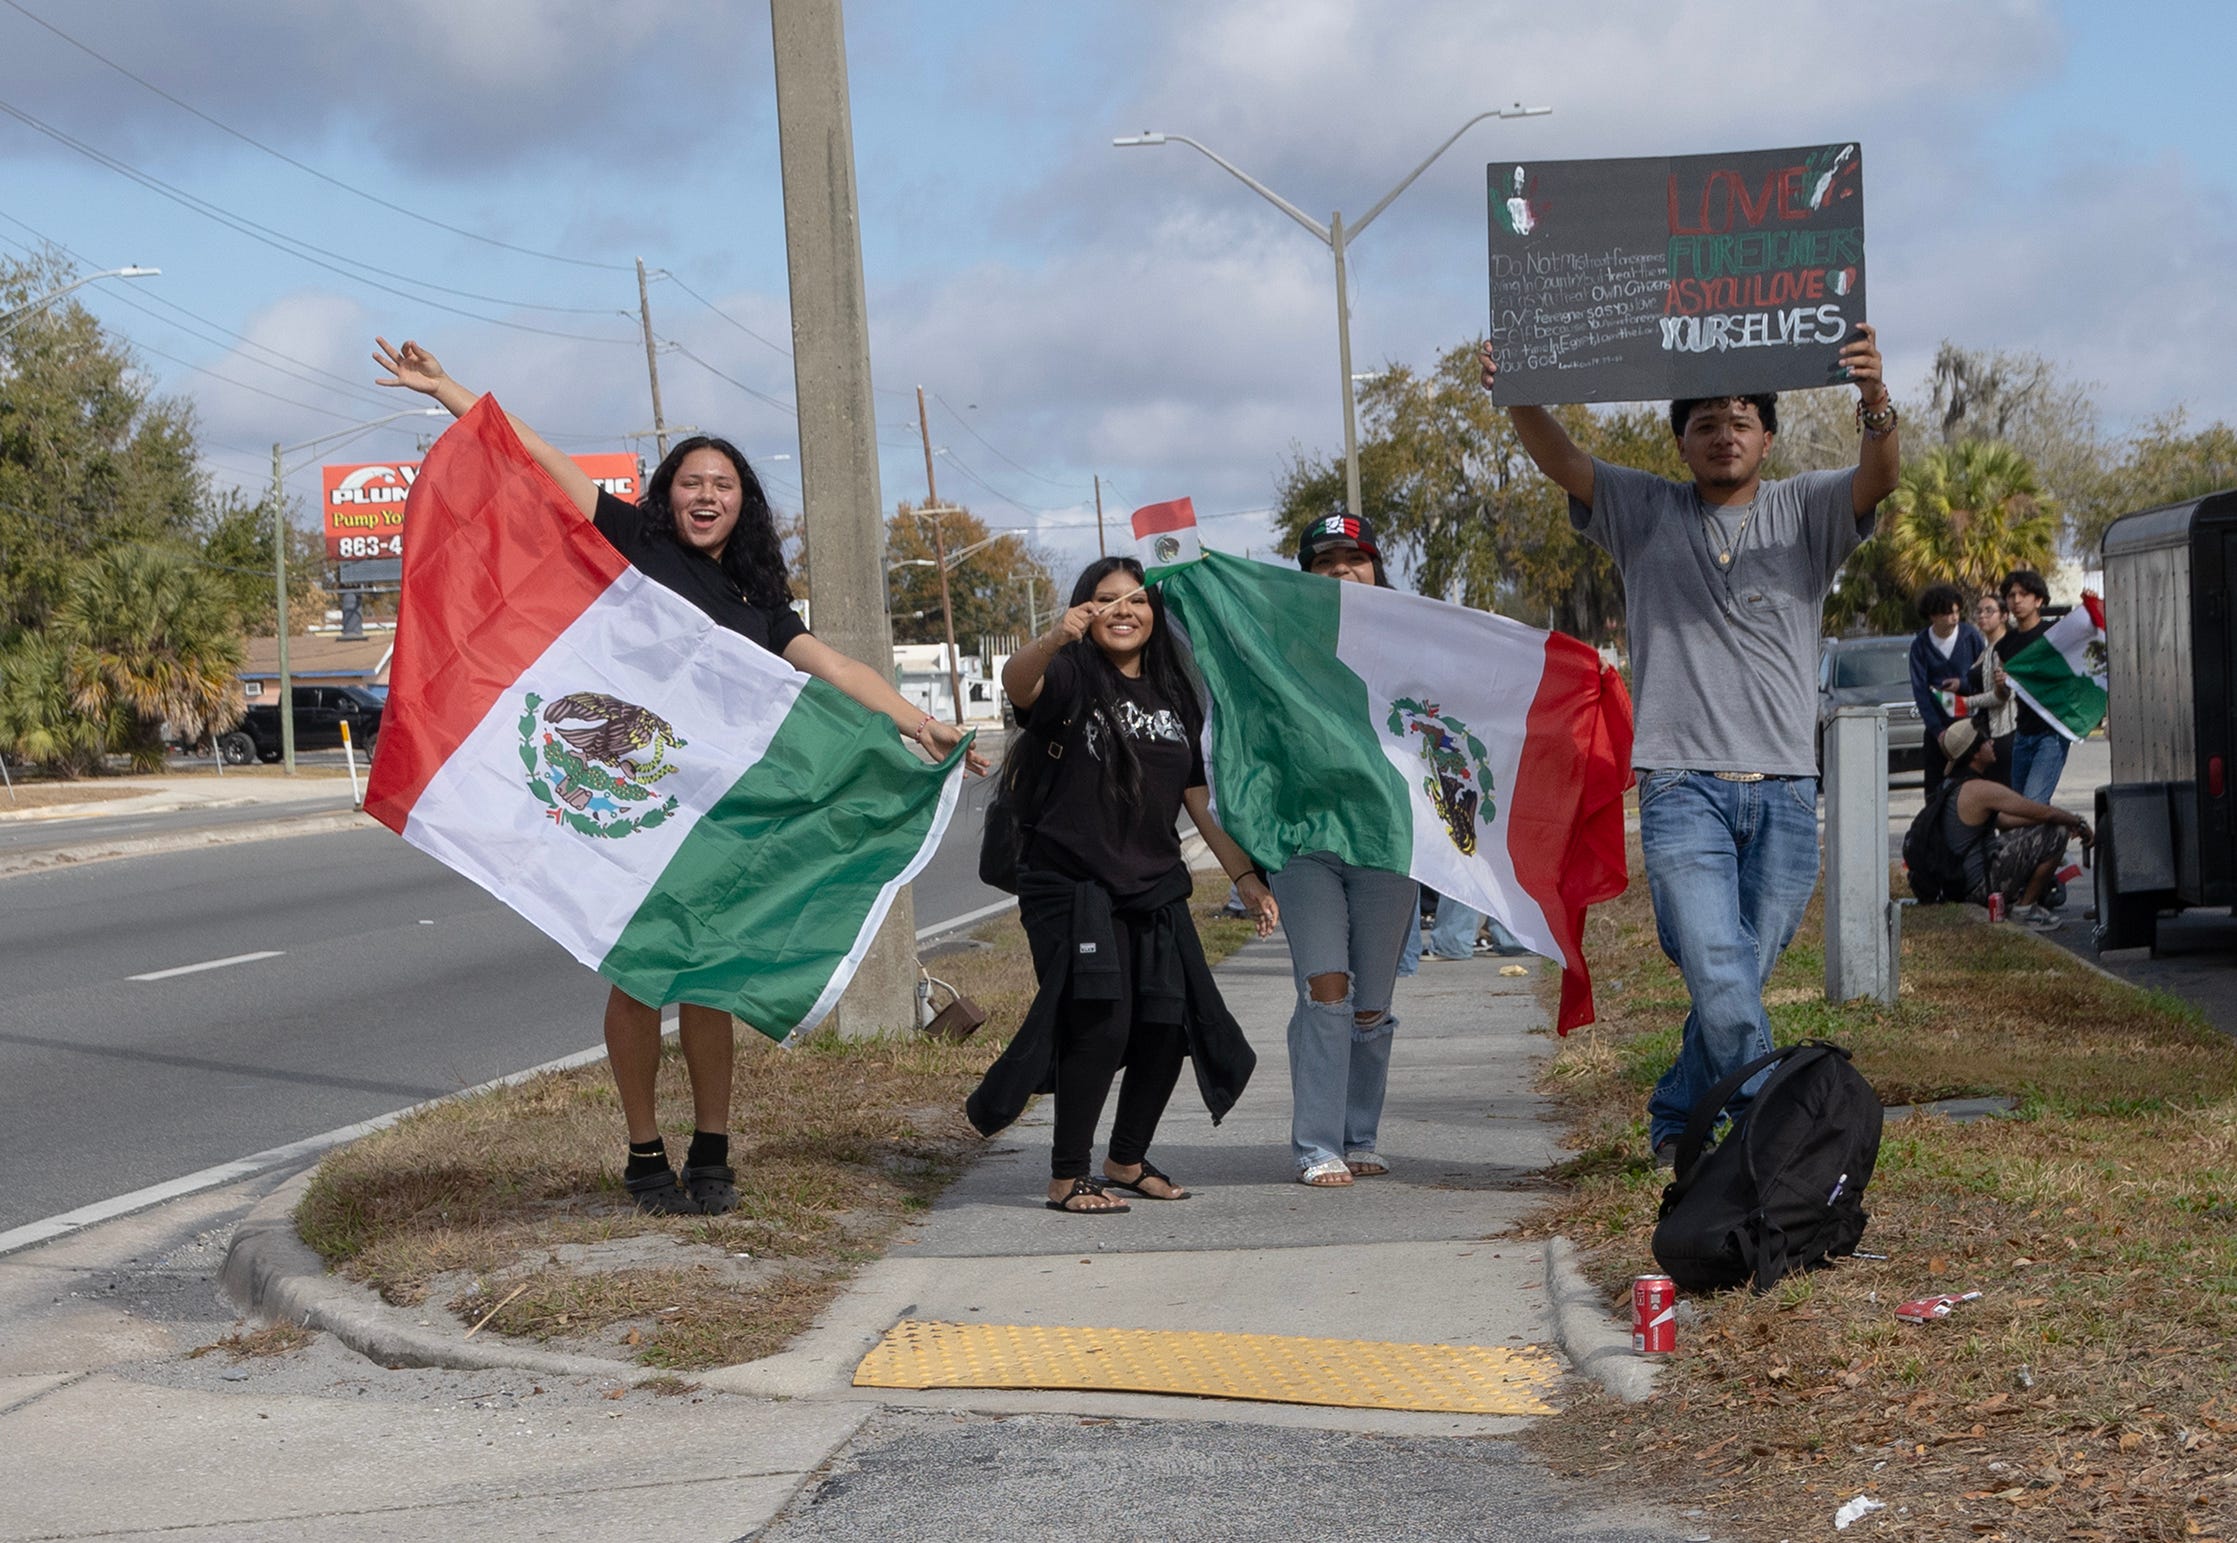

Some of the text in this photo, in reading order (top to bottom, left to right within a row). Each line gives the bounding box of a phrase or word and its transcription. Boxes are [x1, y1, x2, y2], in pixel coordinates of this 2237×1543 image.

[1668, 165, 1812, 235] LOVE
[1668, 227, 1865, 281] FOREIGNERS
[1664, 268, 1825, 316] AS YOU LOVE
[1659, 303, 1848, 353] YOURSELVES
[333, 510, 405, 530] Pump Yo
